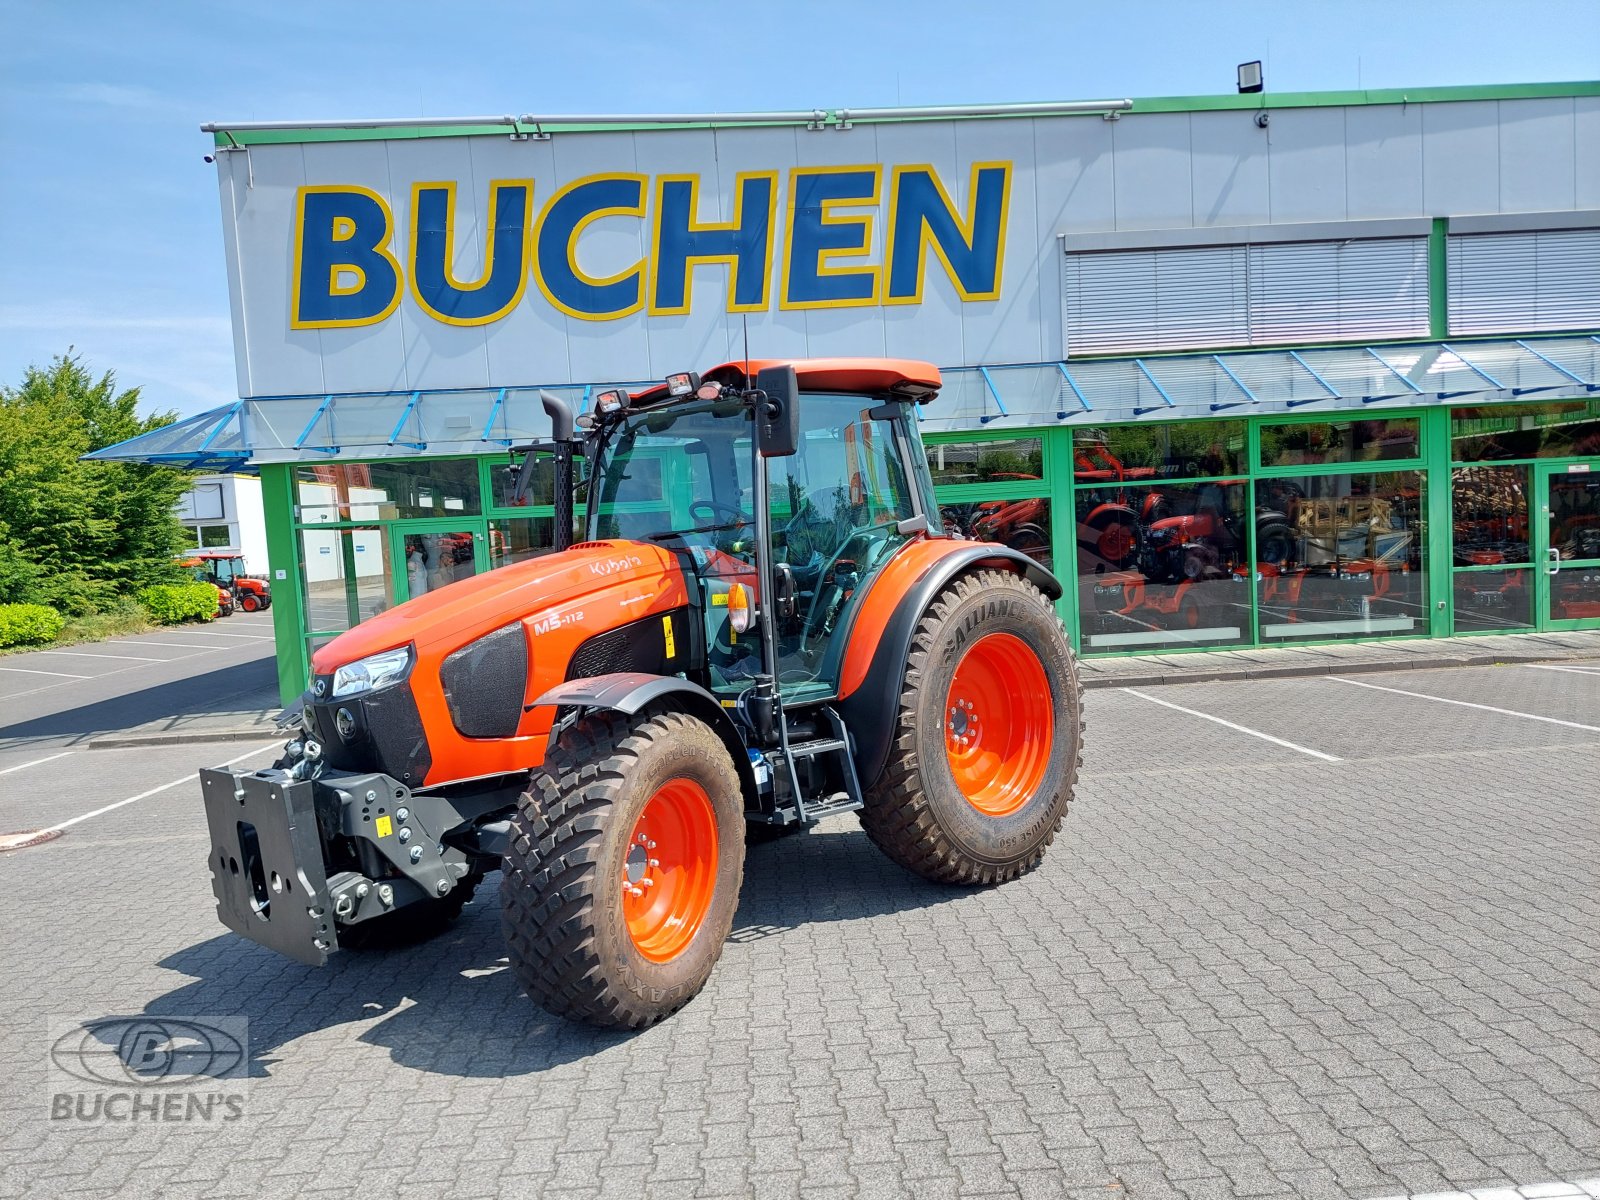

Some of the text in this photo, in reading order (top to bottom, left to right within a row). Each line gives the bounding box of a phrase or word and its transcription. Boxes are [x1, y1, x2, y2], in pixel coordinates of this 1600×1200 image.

[290, 160, 1012, 329] BUCHEN
[589, 555, 642, 576] Kubota
[534, 611, 585, 637] M5-112
[954, 599, 1027, 650] ALLIANCE
[999, 792, 1060, 849] MULTIUSE 550
[616, 951, 716, 1004] GALAXY
